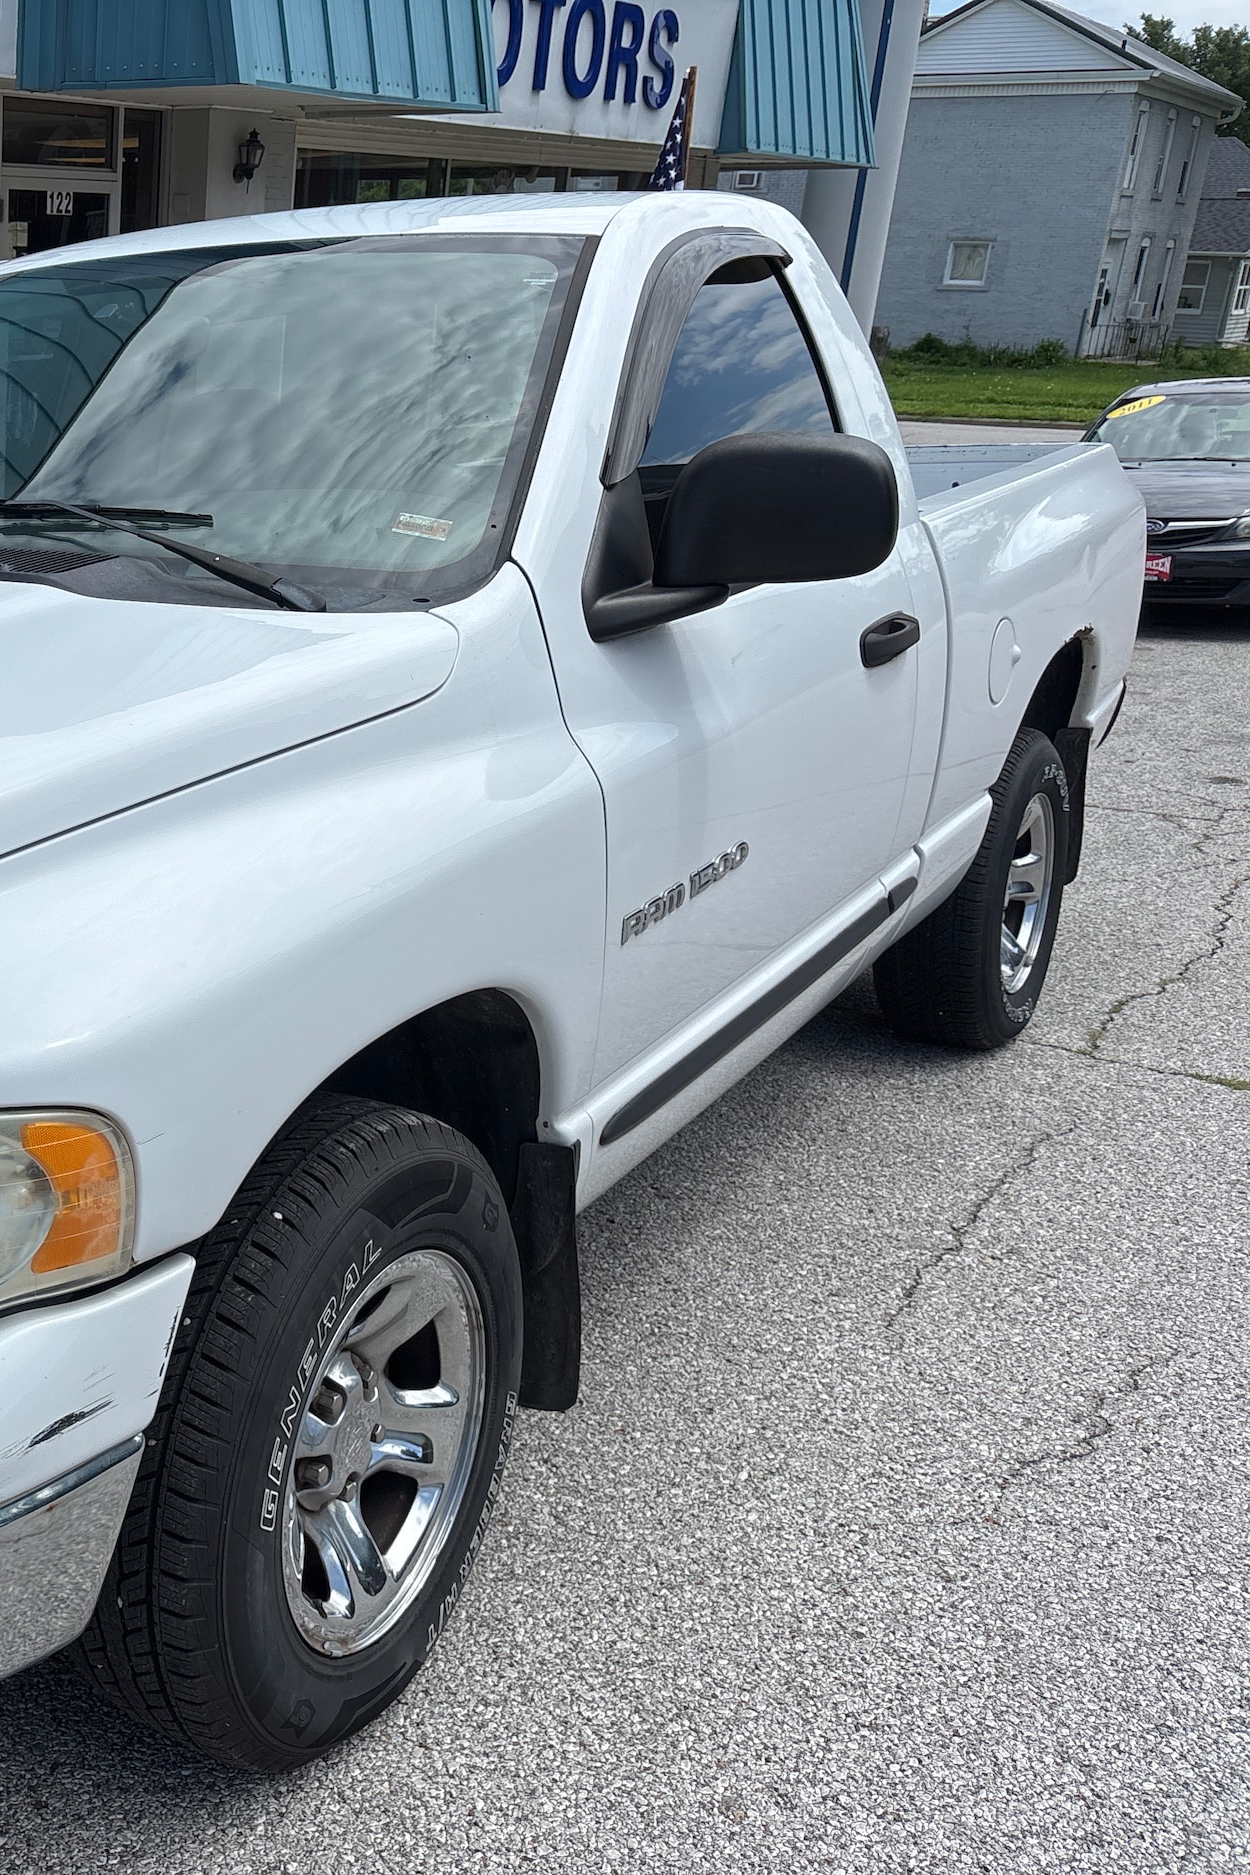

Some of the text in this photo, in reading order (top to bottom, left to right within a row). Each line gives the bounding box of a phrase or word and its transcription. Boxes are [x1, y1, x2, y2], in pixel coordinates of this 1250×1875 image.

[49, 191, 72, 214] 122
[1119, 399, 1153, 416] 2011
[621, 840, 750, 946] RAM 1500
[261, 1240, 382, 1531] GENERAL
